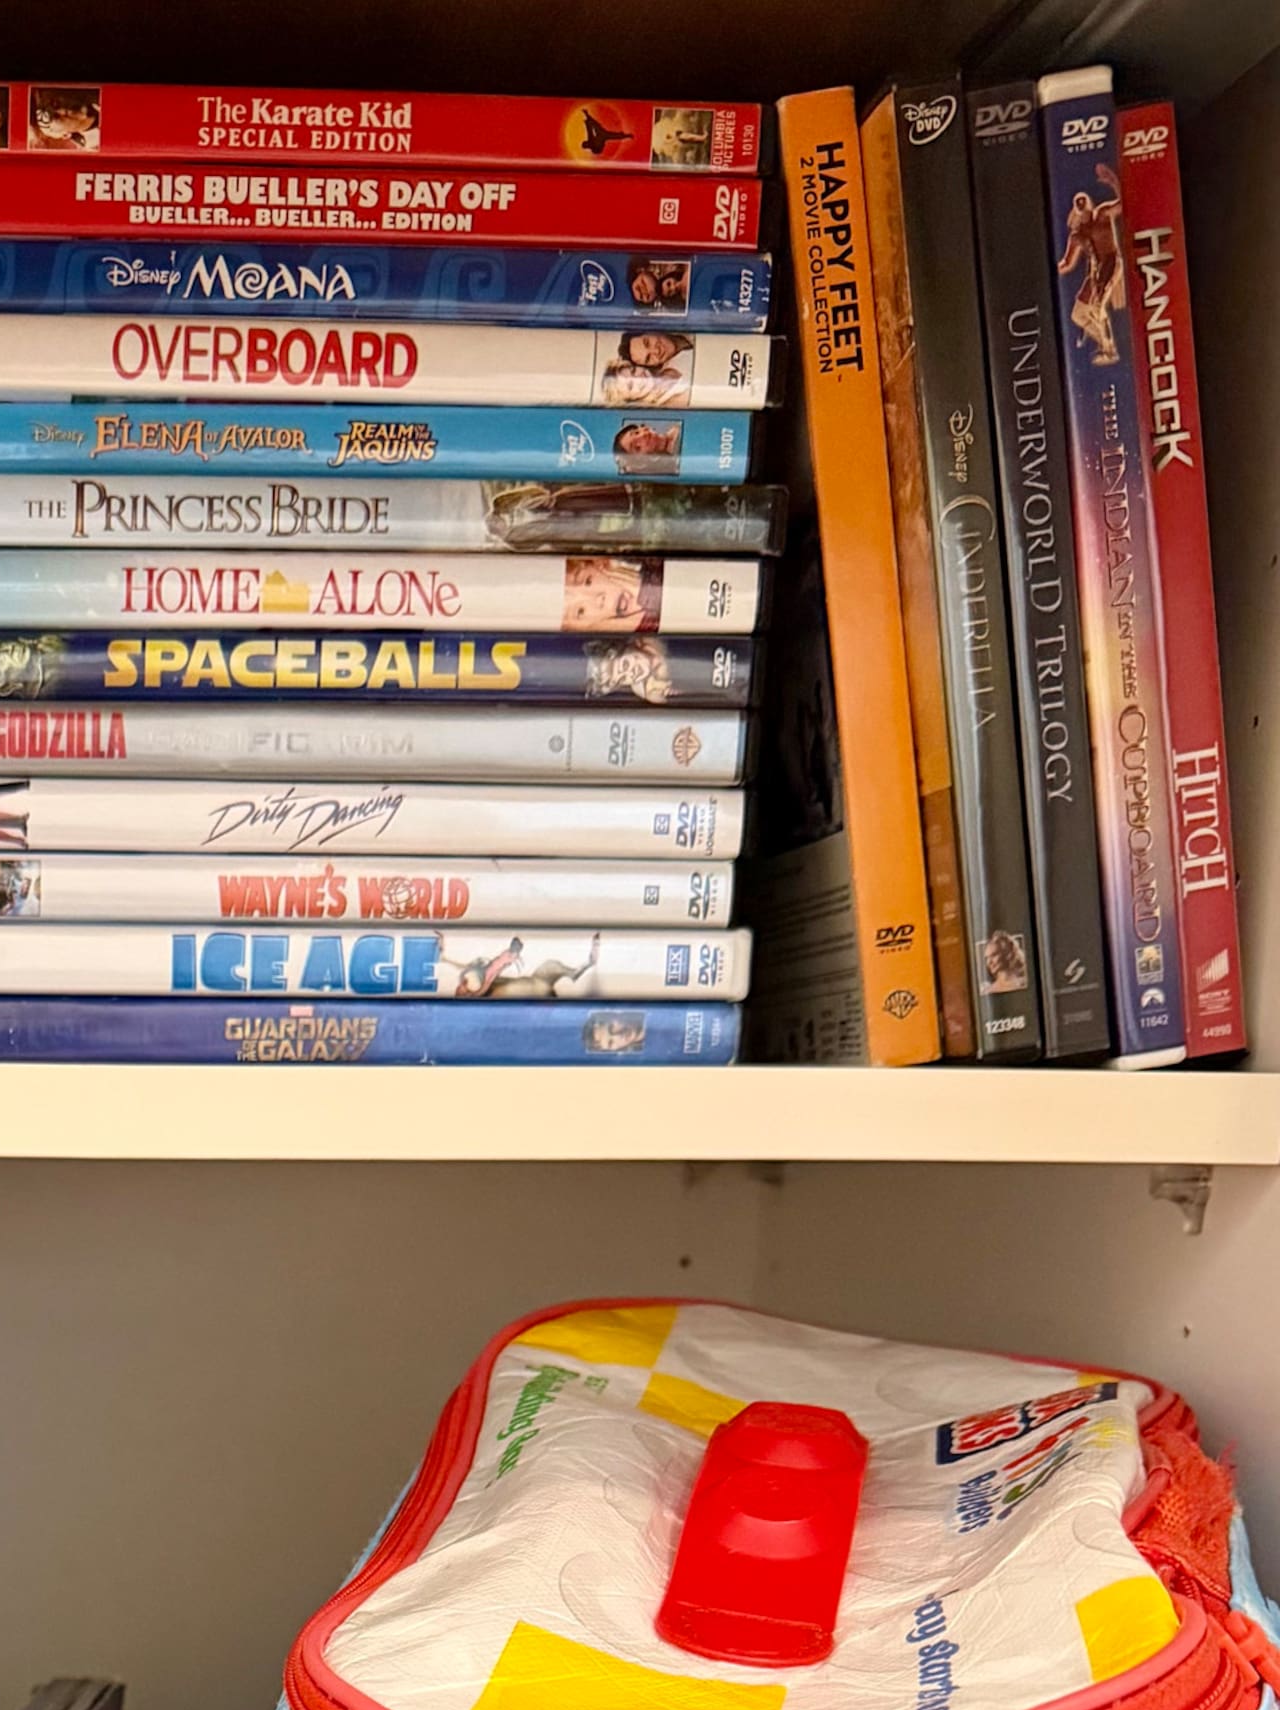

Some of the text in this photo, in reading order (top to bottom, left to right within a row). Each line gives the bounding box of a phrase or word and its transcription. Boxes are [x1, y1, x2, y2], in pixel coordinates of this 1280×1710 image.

[198, 97, 412, 130] The Karate Kid
[1062, 116, 1109, 137] DVD
[198, 128, 411, 153] SPECIAL EDITION
[742, 124, 754, 156] 10130
[76, 173, 516, 210] FERRIS BUELLER'S DAY OFF
[129, 206, 473, 232] BUELLER... BUELLER... EDITION
[183, 255, 355, 300] MOANA
[802, 175, 833, 373] MOVIE COLLECTION
[817, 141, 865, 372] HAPPY FEET
[739, 269, 754, 313] 143277
[112, 322, 418, 388] OVERBOARD
[1133, 227, 1193, 472] HANCOCK
[91, 414, 209, 461] ELENA
[220, 425, 312, 455] AVALOR
[720, 428, 734, 468] 151007
[24, 480, 389, 538] THE PRINCESS BRIDE
[1007, 307, 1072, 803] UNDERWORLD TRILOGY
[122, 567, 260, 614] HOME
[104, 639, 527, 691] SPACEBALLS
[1101, 445, 1162, 942] INDIAN CUPBOARD
[201, 787, 405, 851] Dirty Dancing
[1173, 742, 1228, 897] HITCH
[218, 864, 470, 920] WAYNE'S WORLD
[876, 924, 915, 941] DVD
[171, 933, 440, 994] ICE AGE
[225, 1017, 377, 1041] GUARDIANS
[257, 1039, 371, 1061] GALAXY
